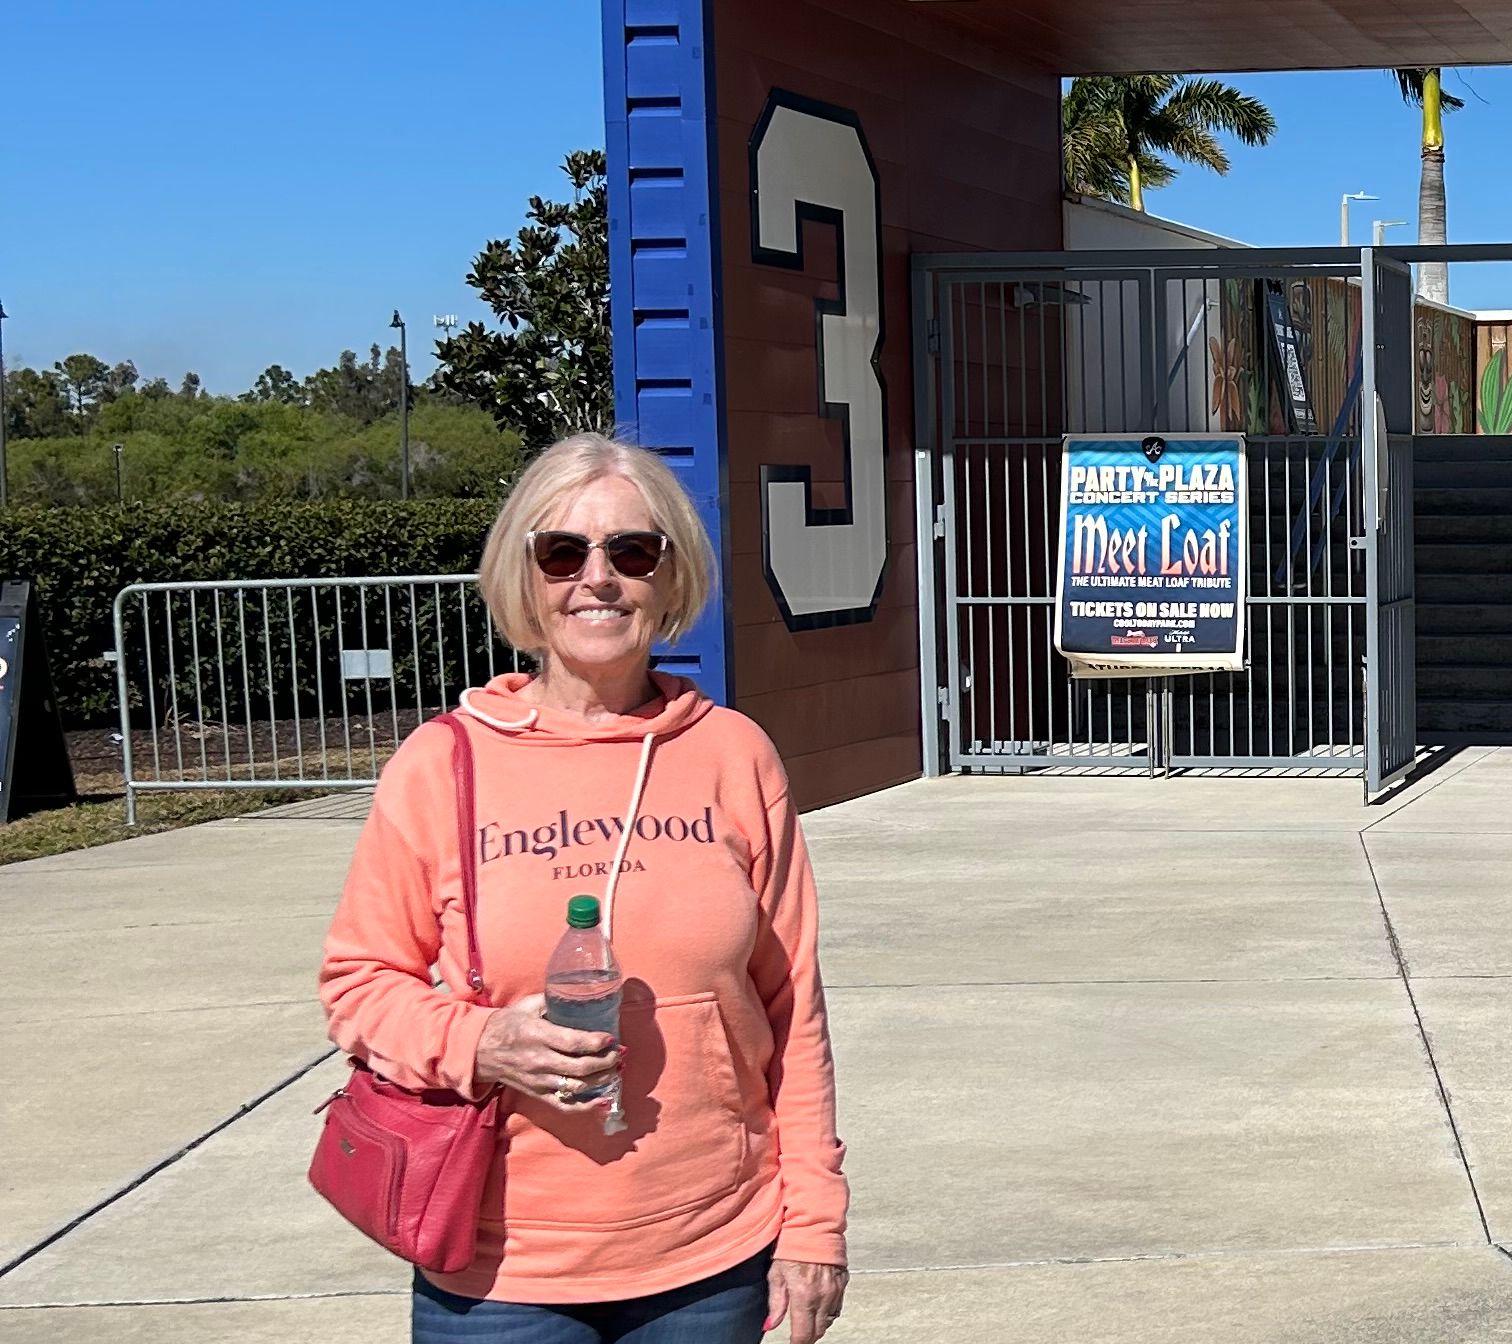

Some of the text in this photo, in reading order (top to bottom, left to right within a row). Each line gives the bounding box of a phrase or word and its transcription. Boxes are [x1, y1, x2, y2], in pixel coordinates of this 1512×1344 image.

[748, 87, 889, 632] 3
[1070, 465, 1147, 492] PARTY
[1159, 464, 1235, 491] PLAZA
[1069, 491, 1234, 504] CONCERT SERIES
[1072, 513, 1231, 576] Meet Loaf
[1071, 576, 1232, 589] THE ULTIMATE MEAT LOAF TRIBUTE
[1069, 601, 1235, 618] TICKETS ON SALE NOW
[1164, 635, 1196, 643] ULTRA
[478, 806, 717, 864] Englewood
